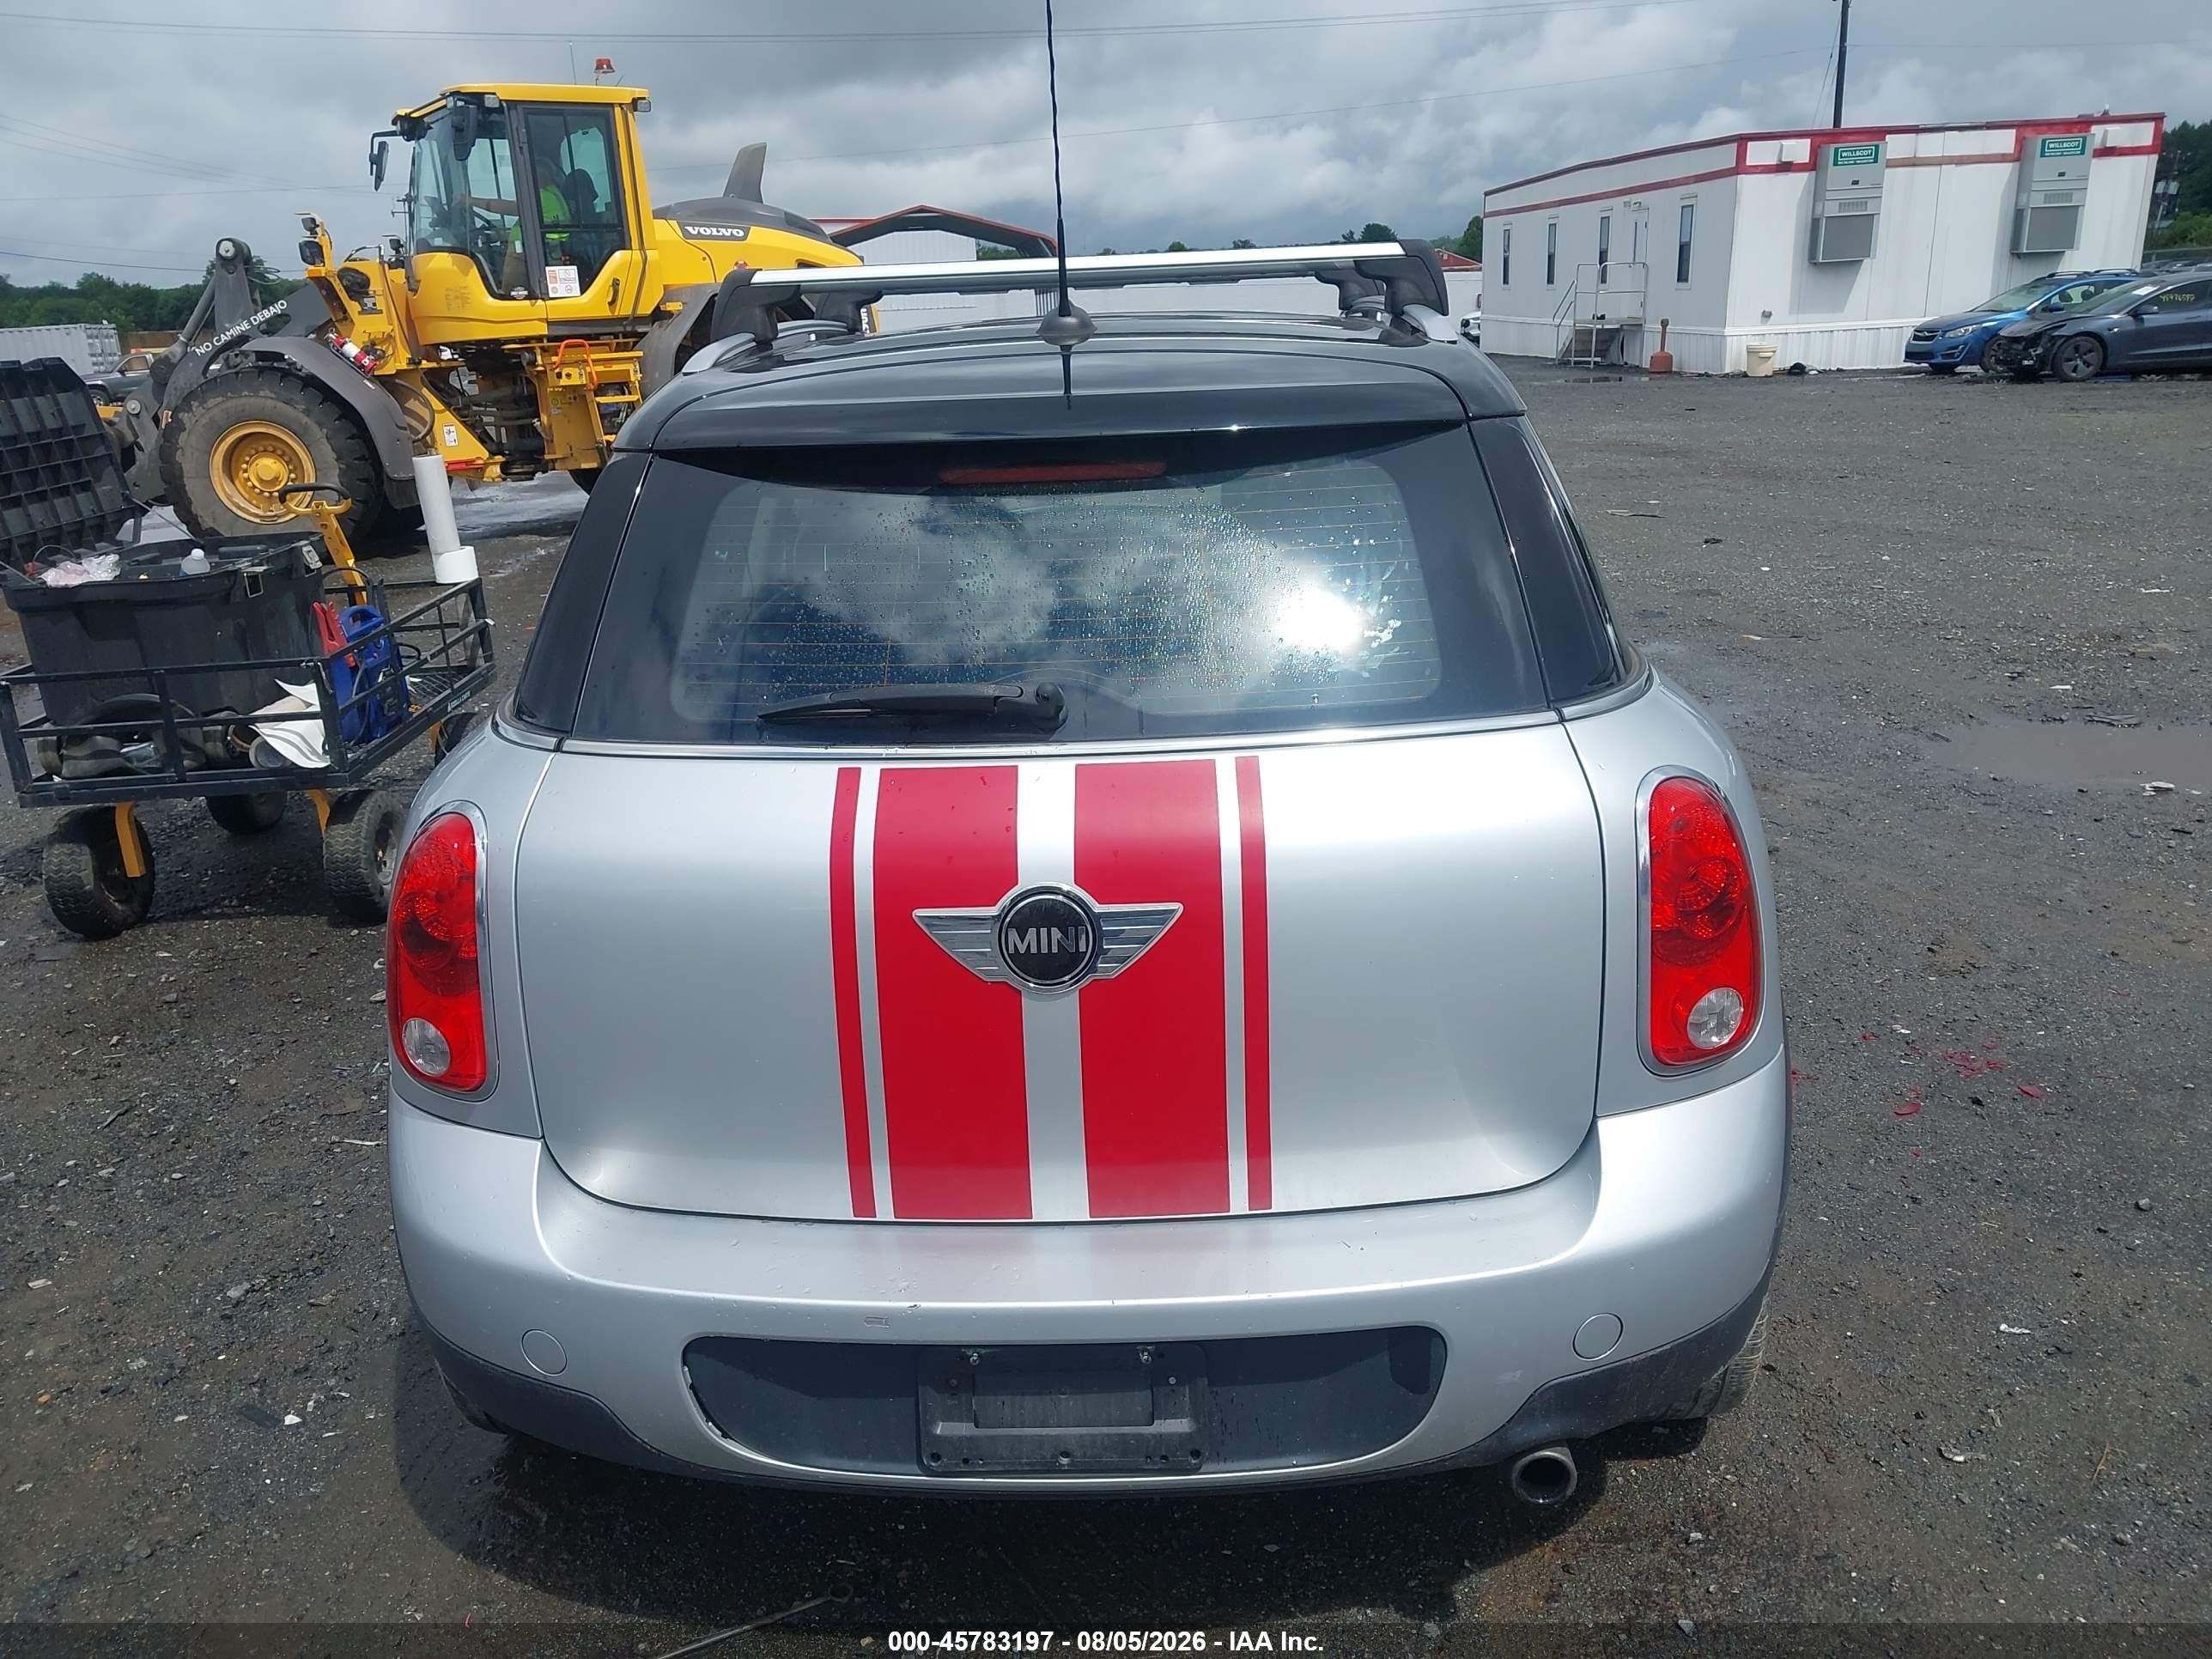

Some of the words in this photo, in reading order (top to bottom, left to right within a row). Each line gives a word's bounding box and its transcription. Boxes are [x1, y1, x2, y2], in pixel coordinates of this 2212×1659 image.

[684, 226, 744, 237] VOLVO
[195, 342, 213, 356] NO
[213, 319, 252, 346] CAMINE
[250, 300, 288, 325] DEBAJO
[1007, 926, 1087, 954] MINI
